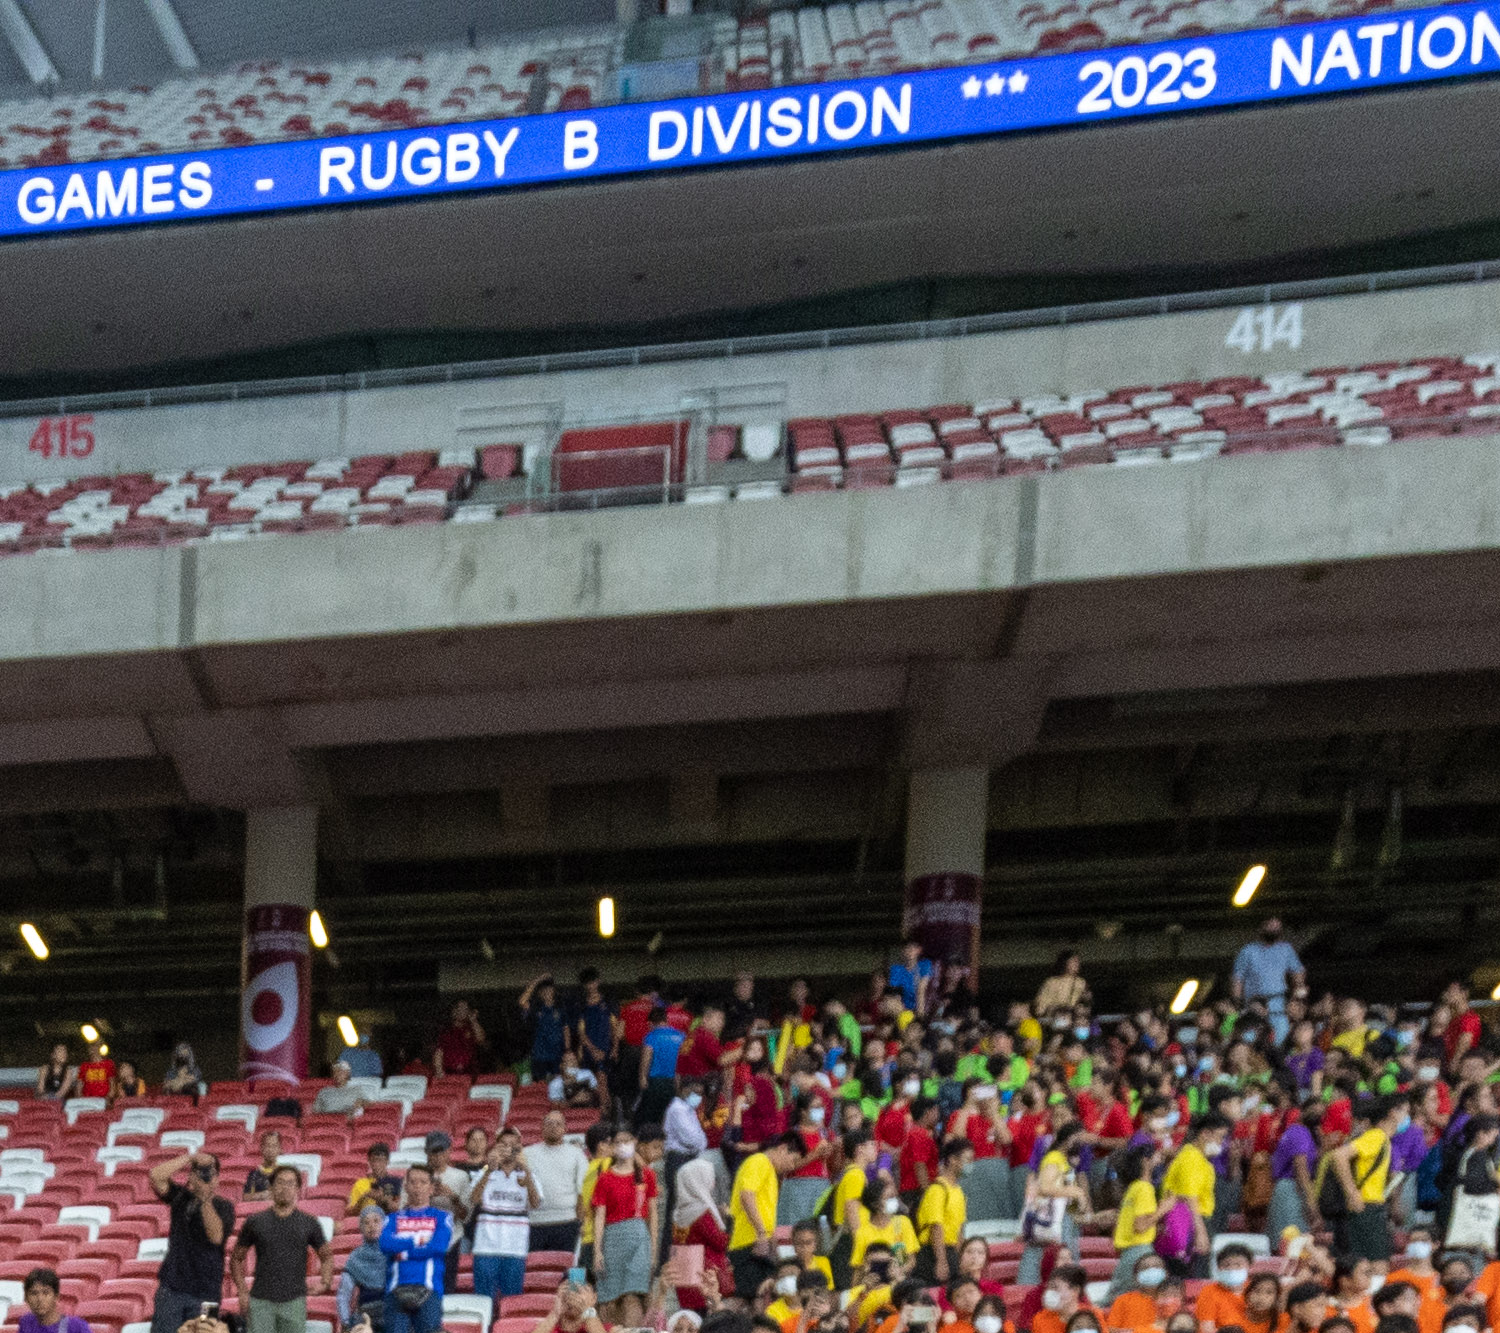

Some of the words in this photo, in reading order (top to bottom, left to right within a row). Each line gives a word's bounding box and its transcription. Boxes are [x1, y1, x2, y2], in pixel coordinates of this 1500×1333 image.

[17, 161, 213, 225] GAMES
[319, 127, 520, 196] RUGBY
[563, 119, 599, 170] B
[648, 83, 912, 161] DIVISION
[1077, 47, 1217, 114] 2023
[1225, 302, 1303, 351] 414
[29, 412, 95, 459] 415
